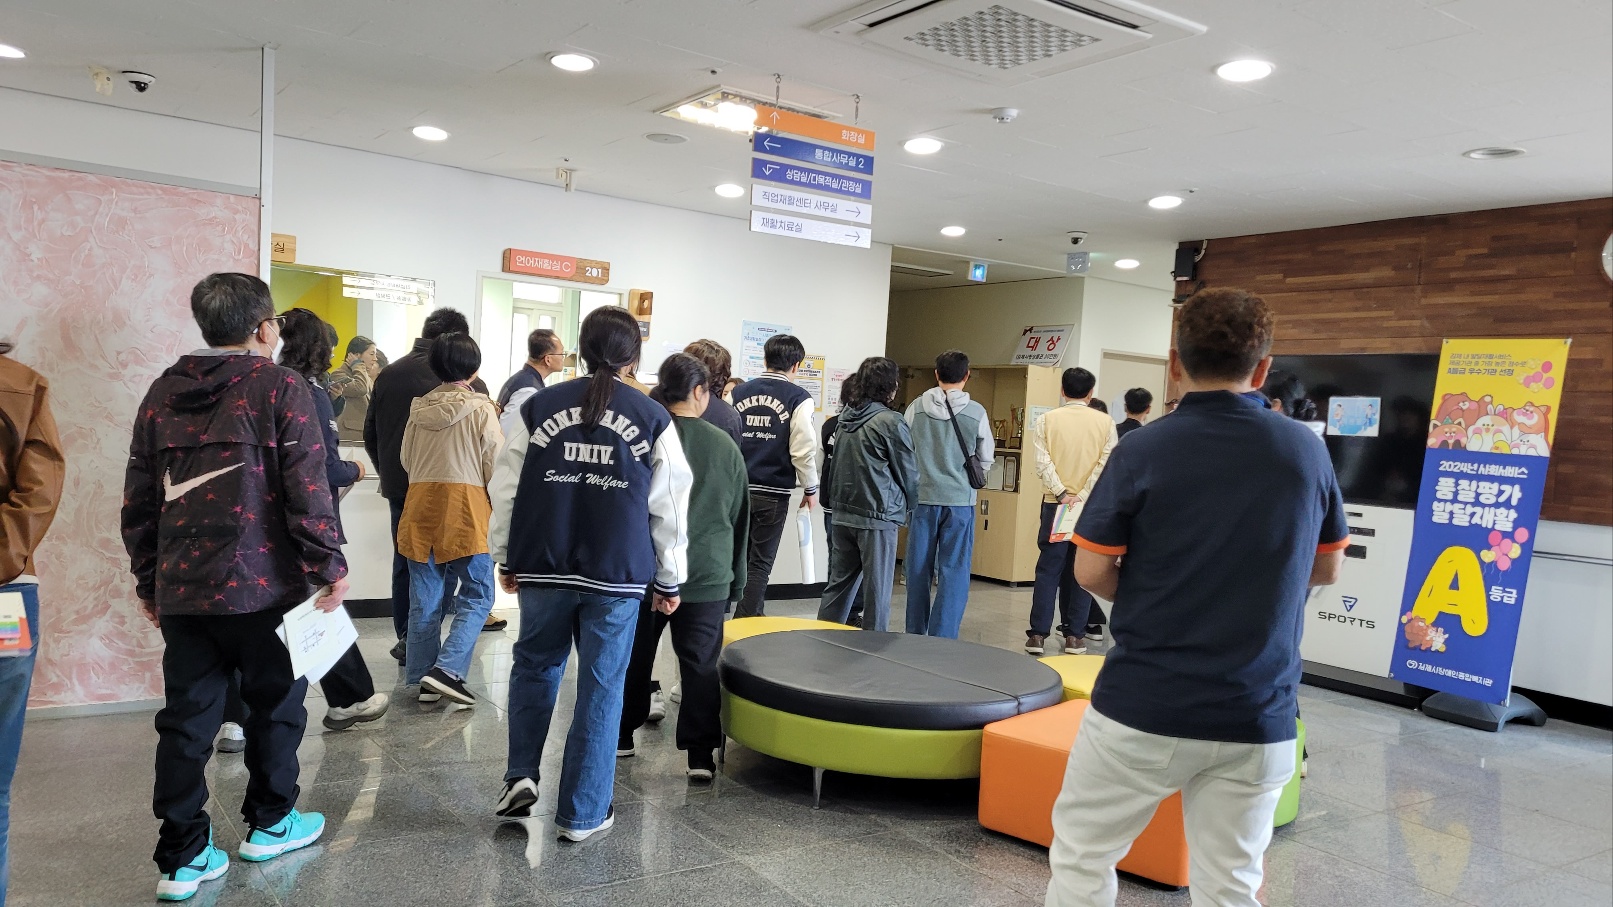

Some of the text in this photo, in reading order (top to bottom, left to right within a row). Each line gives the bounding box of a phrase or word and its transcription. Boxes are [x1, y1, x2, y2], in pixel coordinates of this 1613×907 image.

[841, 130, 866, 144] 화장실
[814, 148, 865, 169] 통합사무실 2
[762, 190, 838, 213] 직업재활센터 사무실
[760, 216, 803, 233] 재활치료실
[515, 255, 602, 278] 언어재활실 C 201
[1468, 367, 1498, 376] 우수기관
[733, 394, 785, 415] ONKWANG
[529, 406, 640, 449] WONKANG
[745, 414, 772, 427] UNIV.
[563, 441, 614, 465] UNIV.
[543, 469, 629, 490] Social Welfare
[1438, 460, 1529, 479] 2024년 사회서비스
[1435, 476, 1523, 506] 품질평가
[1431, 501, 1519, 532] 발달재활
[1411, 545, 1518, 637] A 등급
[1317, 610, 1376, 629] SPORTS
